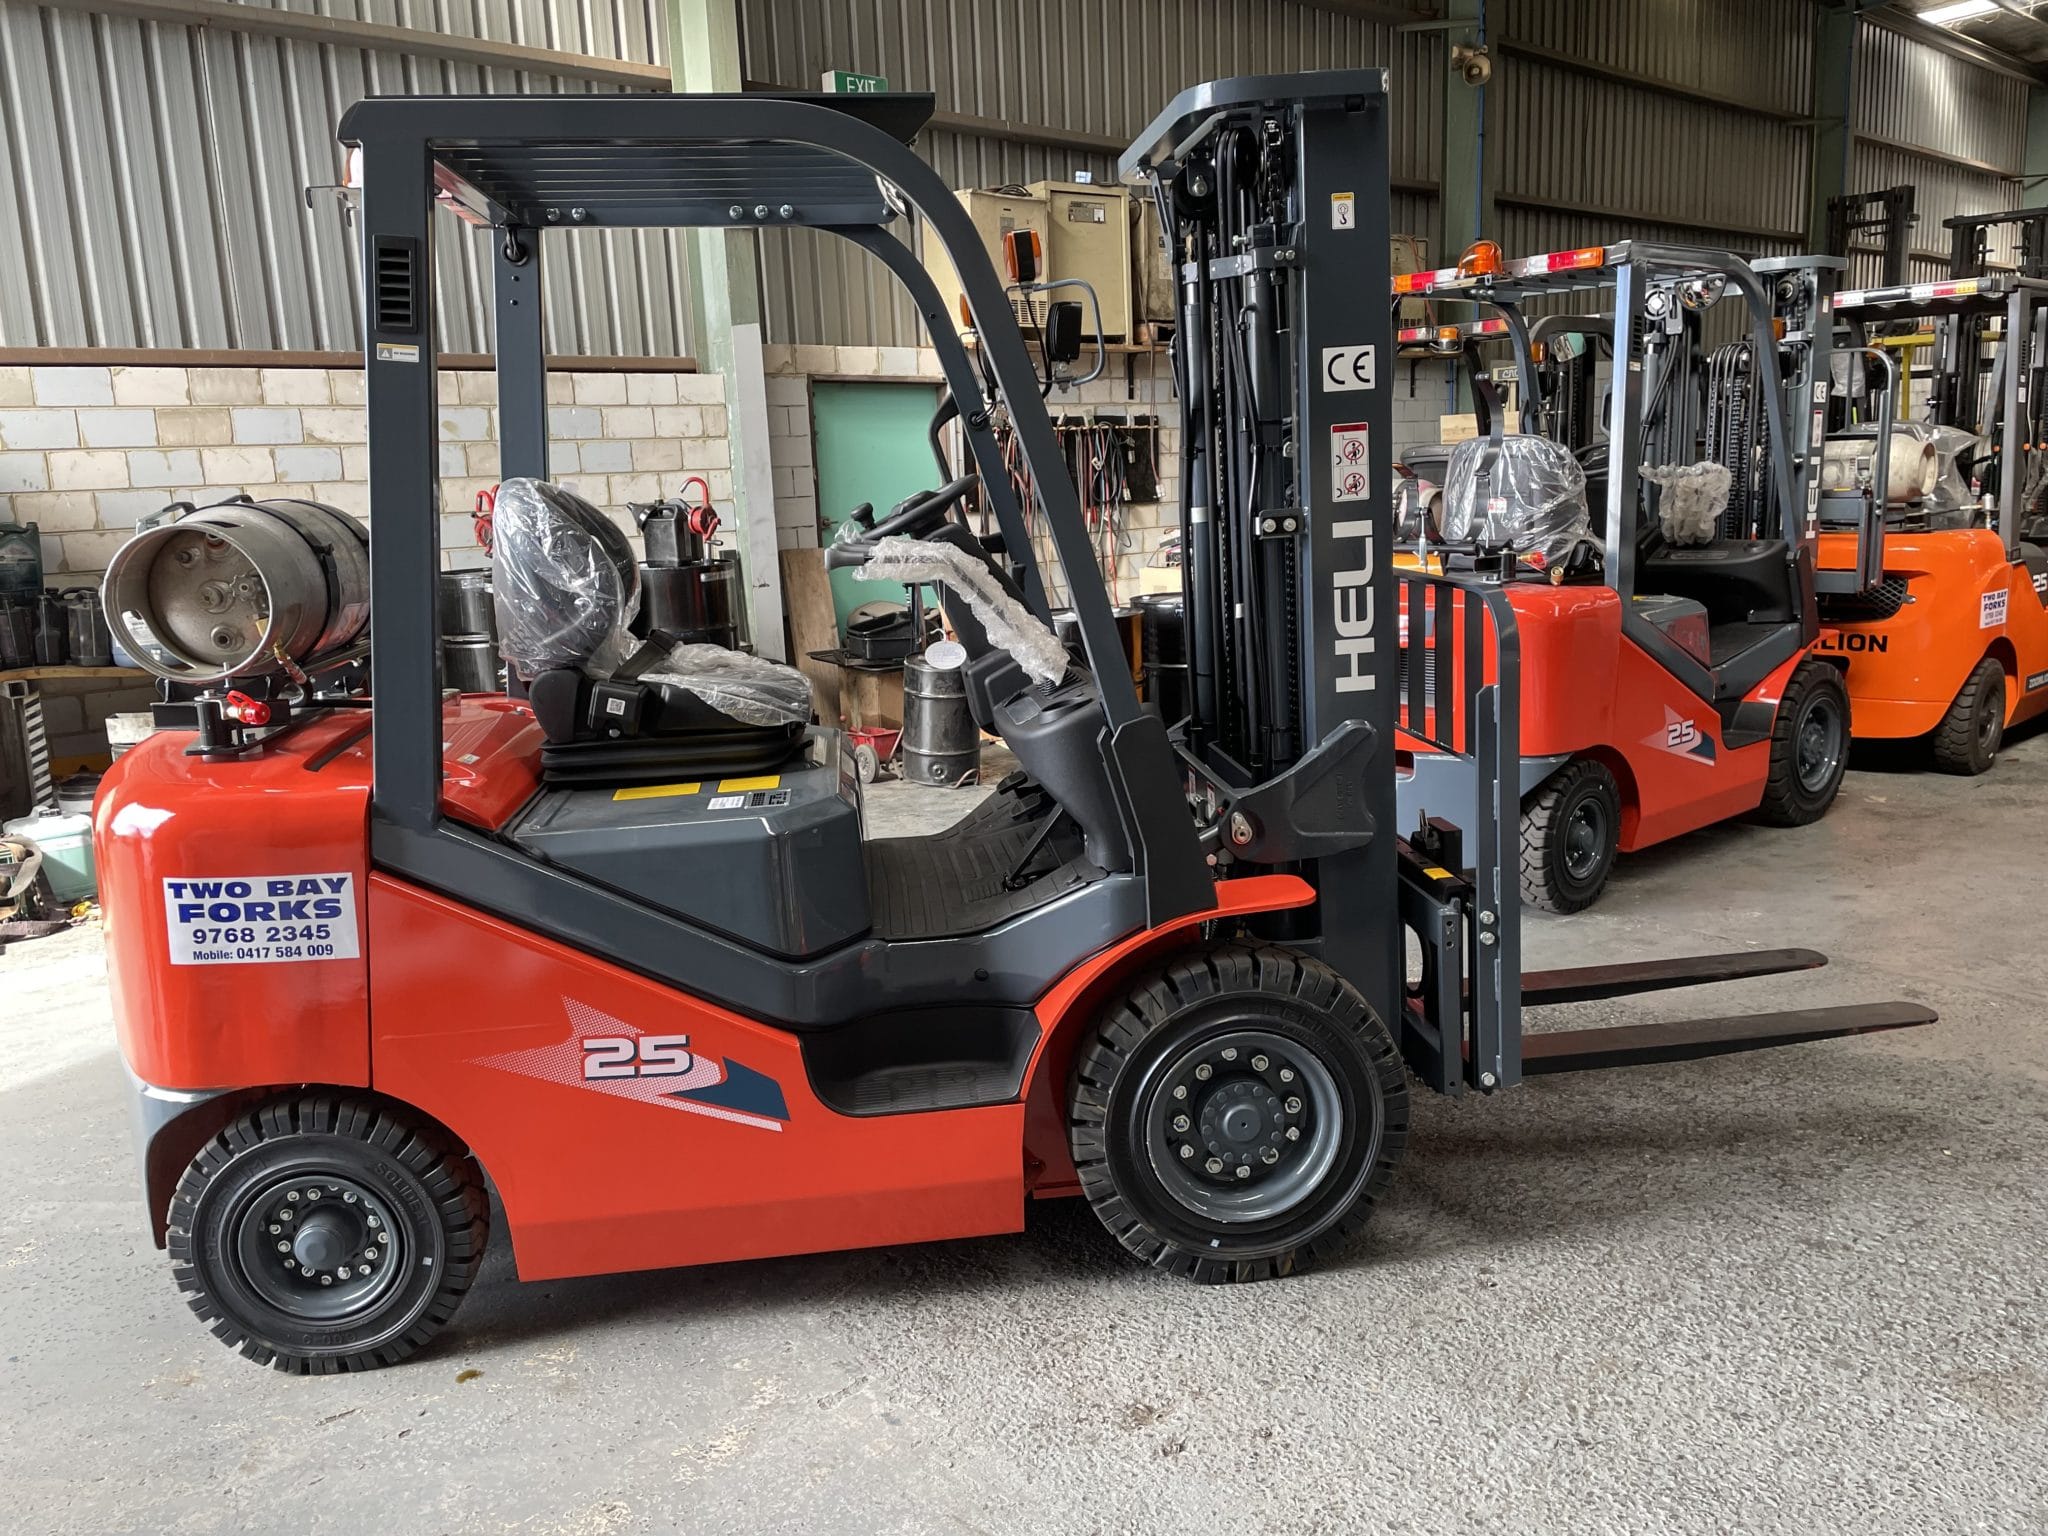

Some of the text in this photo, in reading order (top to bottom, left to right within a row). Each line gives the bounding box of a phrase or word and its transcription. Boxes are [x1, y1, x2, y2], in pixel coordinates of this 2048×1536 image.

[846, 76, 876, 93] EXIT
[1805, 456, 1821, 539] HELI
[1332, 519, 1376, 693] HELI
[1813, 633, 1888, 653] LION
[1667, 719, 1696, 748] 25
[168, 877, 348, 899] TWO BAY
[178, 898, 342, 924] FORKS
[192, 924, 331, 944] 9768 2345
[192, 943, 334, 961] Mobile: 0417 584 009
[583, 1034, 694, 1081] 25
